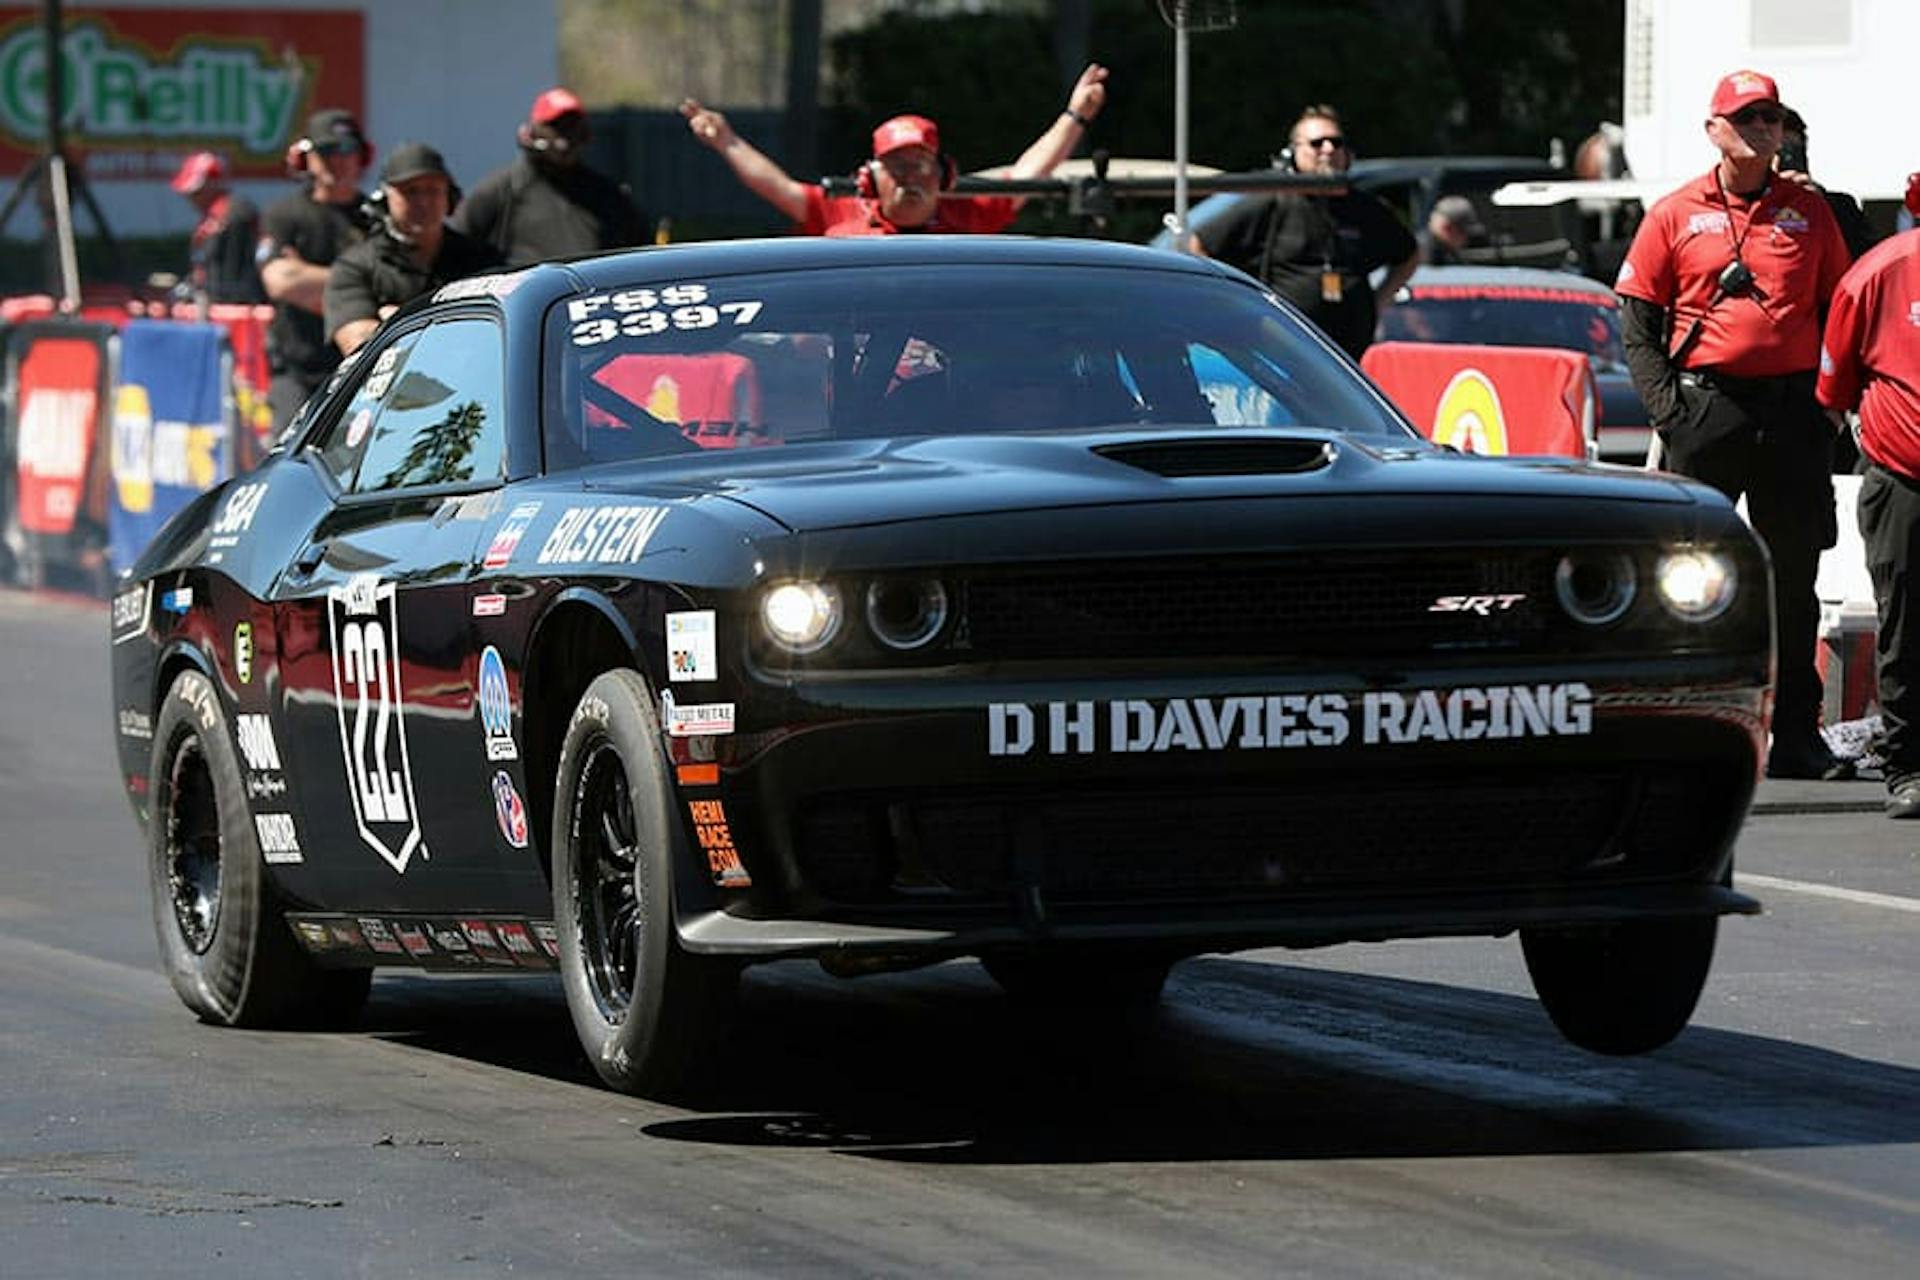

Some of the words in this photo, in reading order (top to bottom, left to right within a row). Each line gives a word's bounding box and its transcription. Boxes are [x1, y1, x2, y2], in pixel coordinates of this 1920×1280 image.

[2, 34, 294, 142] O'Reilly
[568, 284, 709, 321] FSS
[572, 302, 763, 346] 3397
[538, 507, 670, 564] BILSTEIN
[1428, 594, 1526, 615] SRT
[343, 621, 409, 823] 22
[989, 703, 1034, 755] D
[1049, 701, 1095, 754] H
[1110, 694, 1349, 753] DAVIES
[1363, 683, 1592, 744] RACING
